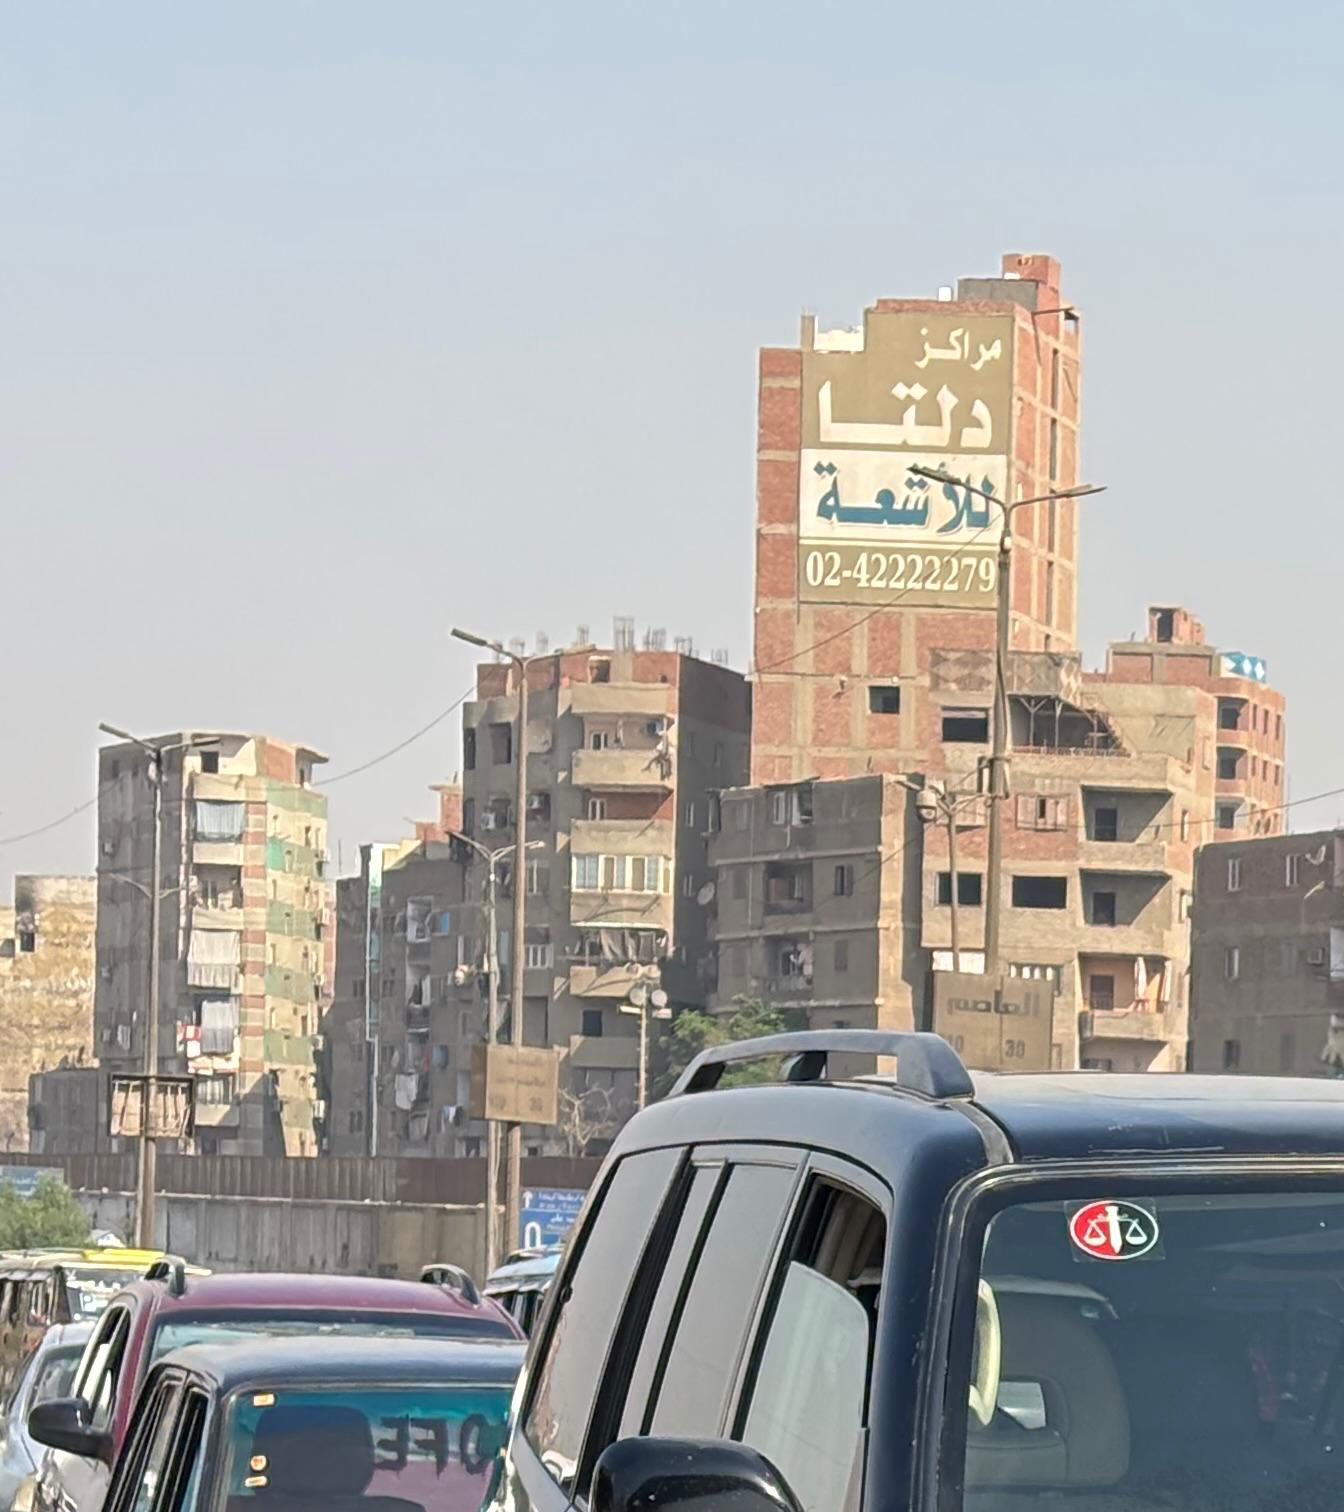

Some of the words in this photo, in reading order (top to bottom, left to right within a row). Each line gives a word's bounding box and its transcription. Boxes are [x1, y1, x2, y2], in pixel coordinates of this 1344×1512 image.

[914, 326, 1002, 371] مراكز
[817, 380, 994, 449] دلتا
[805, 550, 997, 593] 02-42222279
